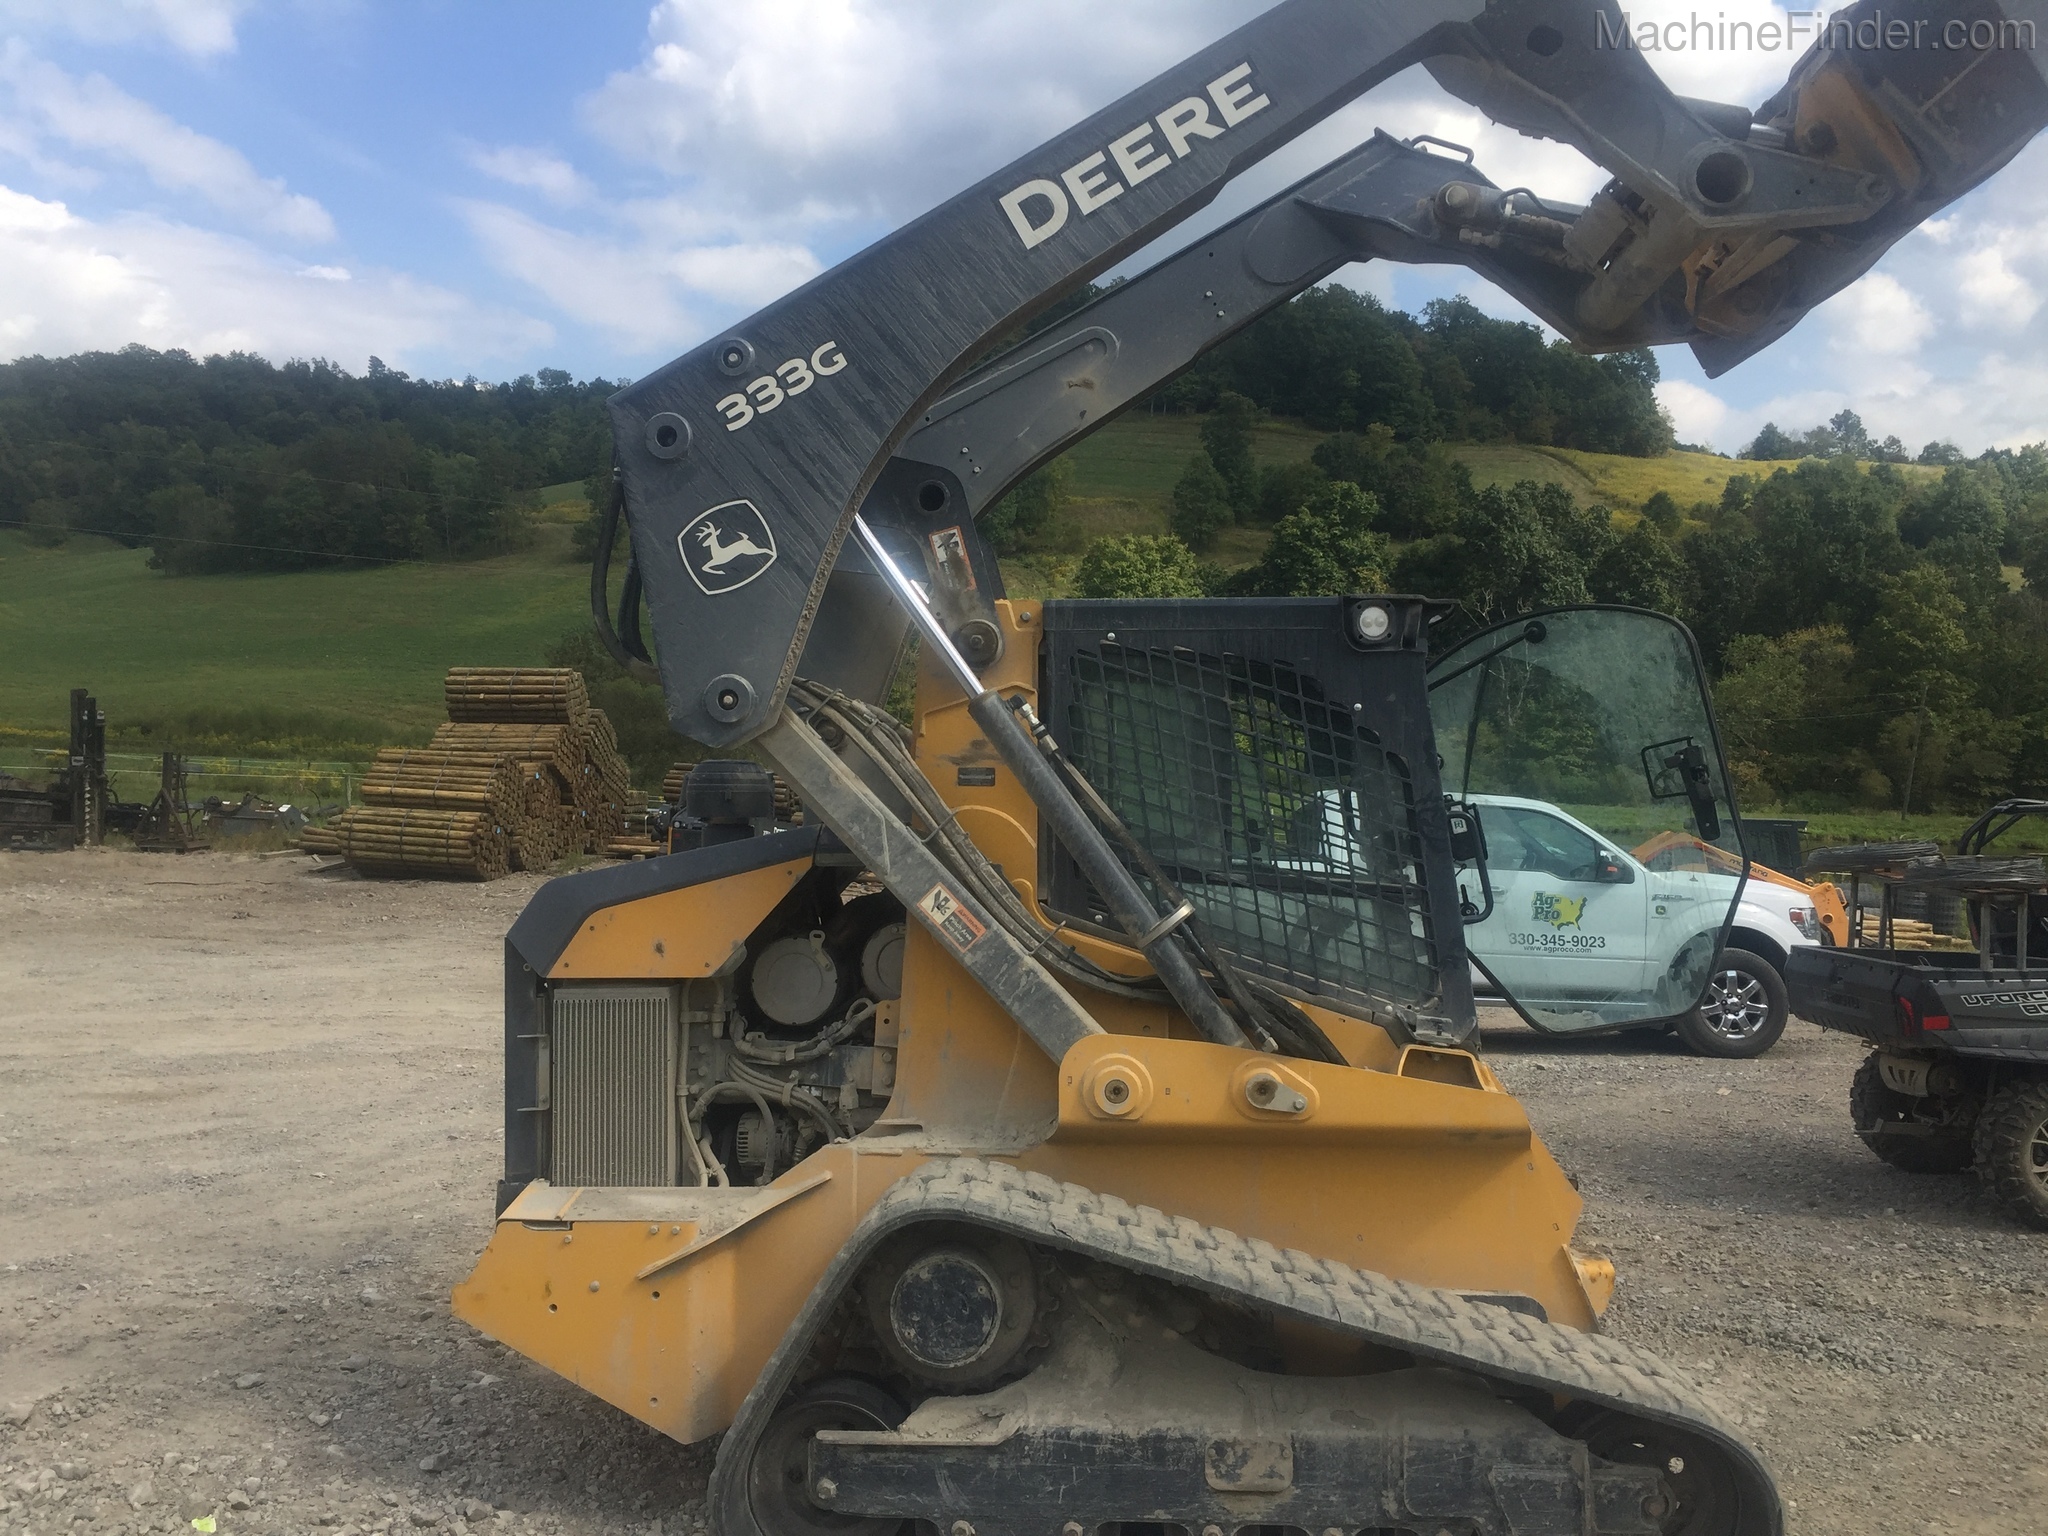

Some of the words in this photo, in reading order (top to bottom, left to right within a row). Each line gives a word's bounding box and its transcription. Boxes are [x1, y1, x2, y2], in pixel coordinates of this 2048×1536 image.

[999, 61, 1271, 250] DEERE
[715, 340, 848, 432] 333G
[1532, 891, 1561, 909] Ag-
[1532, 906, 1561, 921] Pro
[948, 915, 963, 930] Pinch
[960, 927, 973, 940] Area
[1508, 932, 1606, 949] 330-345-9023
[1523, 945, 1592, 953] www.agproco.com
